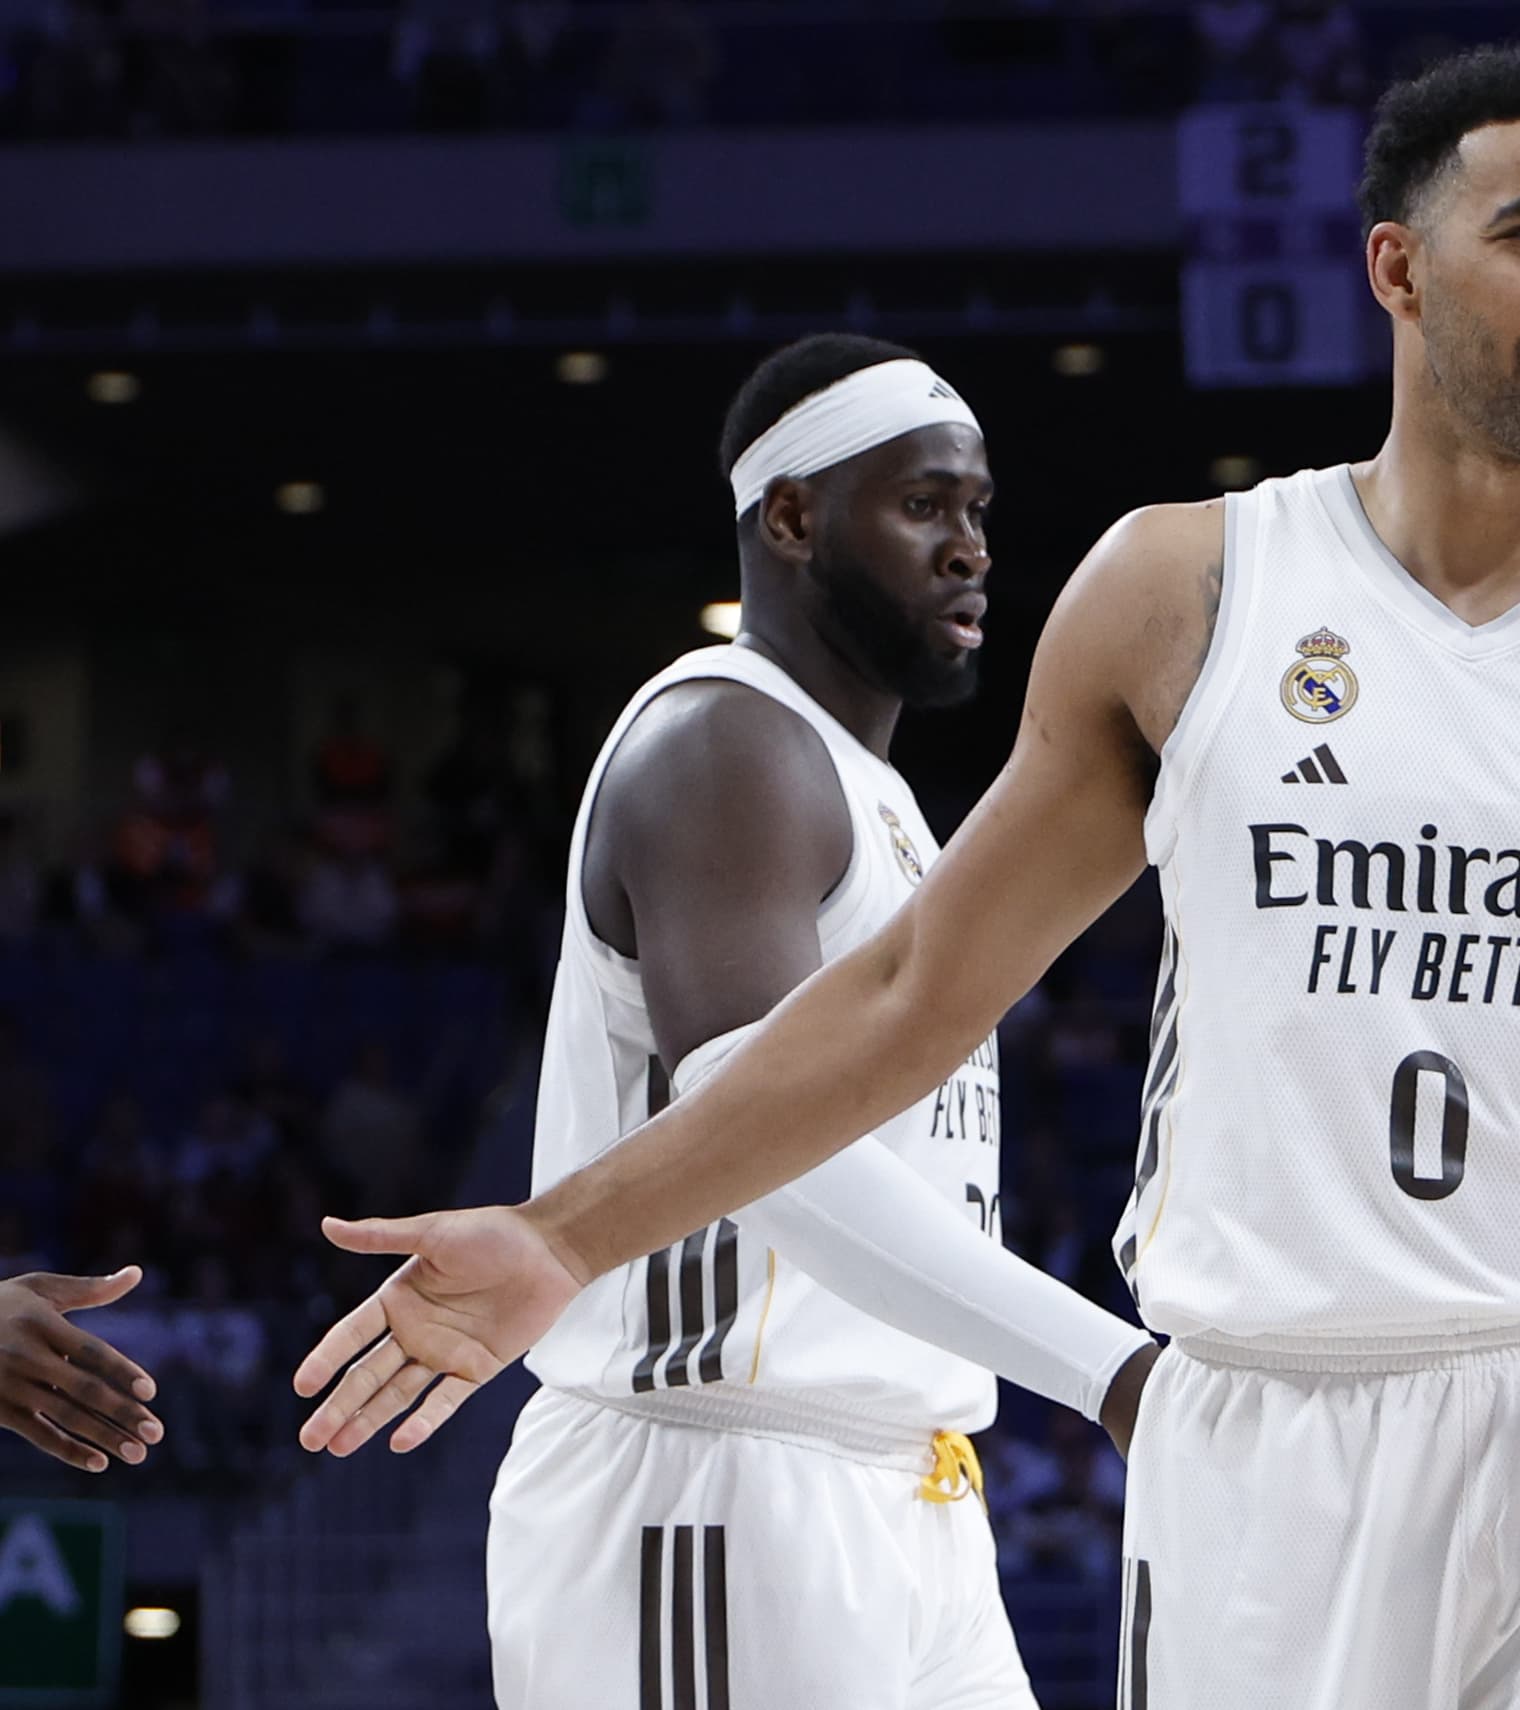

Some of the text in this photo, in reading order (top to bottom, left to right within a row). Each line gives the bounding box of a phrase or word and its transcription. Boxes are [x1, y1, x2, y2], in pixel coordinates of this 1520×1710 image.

[1237, 122, 1294, 198] 2
[1306, 924, 1398, 995] FLY
[930, 1078, 967, 1140] FLY
[1389, 1049, 1470, 1201] 0
